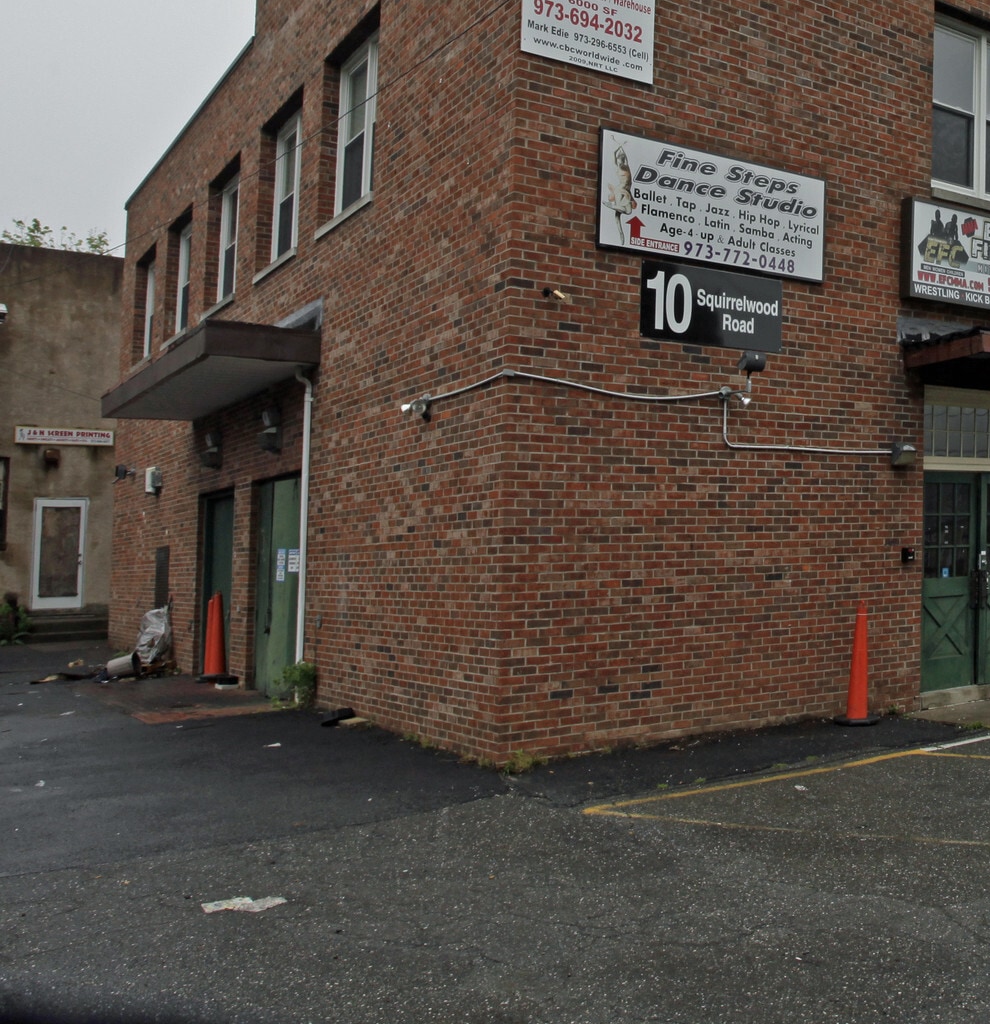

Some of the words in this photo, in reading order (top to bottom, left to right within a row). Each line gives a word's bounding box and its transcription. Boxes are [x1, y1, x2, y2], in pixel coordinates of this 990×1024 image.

[602, 6, 618, 17] SF
[527, 19, 549, 33] Mark
[551, 26, 570, 39] Edie
[574, 33, 627, 54] 973-296-6553
[629, 48, 649, 63] (Cell)
[605, 65, 618, 73] LLC
[658, 149, 717, 176] Fine
[726, 166, 800, 195] Steps
[634, 166, 727, 199] Dance
[736, 189, 818, 218] Studio
[634, 188, 667, 204] Ballet
[676, 197, 697, 212] Tap
[705, 203, 730, 217] Jazz
[738, 210, 757, 224] Hip
[759, 213, 780, 228] Hop
[788, 220, 820, 235] Lyrical
[641, 204, 695, 224] Flamenco
[704, 216, 730, 231] Latin
[739, 223, 775, 240] Samba
[782, 232, 813, 249] Acting
[630, 236, 645, 247] SIDE
[646, 239, 679, 252] ENTRANCE
[683, 241, 795, 274] 973-772-0448
[700, 232, 714, 243] up
[717, 235, 725, 244] &
[727, 235, 756, 250] Adult
[760, 242, 796, 257] Classes
[924, 237, 964, 269] EFC
[646, 270, 693, 334] 10
[696, 288, 779, 317] Squirrelwood
[914, 284, 960, 300] WRESTLING
[965, 294, 984, 305] KICK
[722, 313, 755, 334] Road
